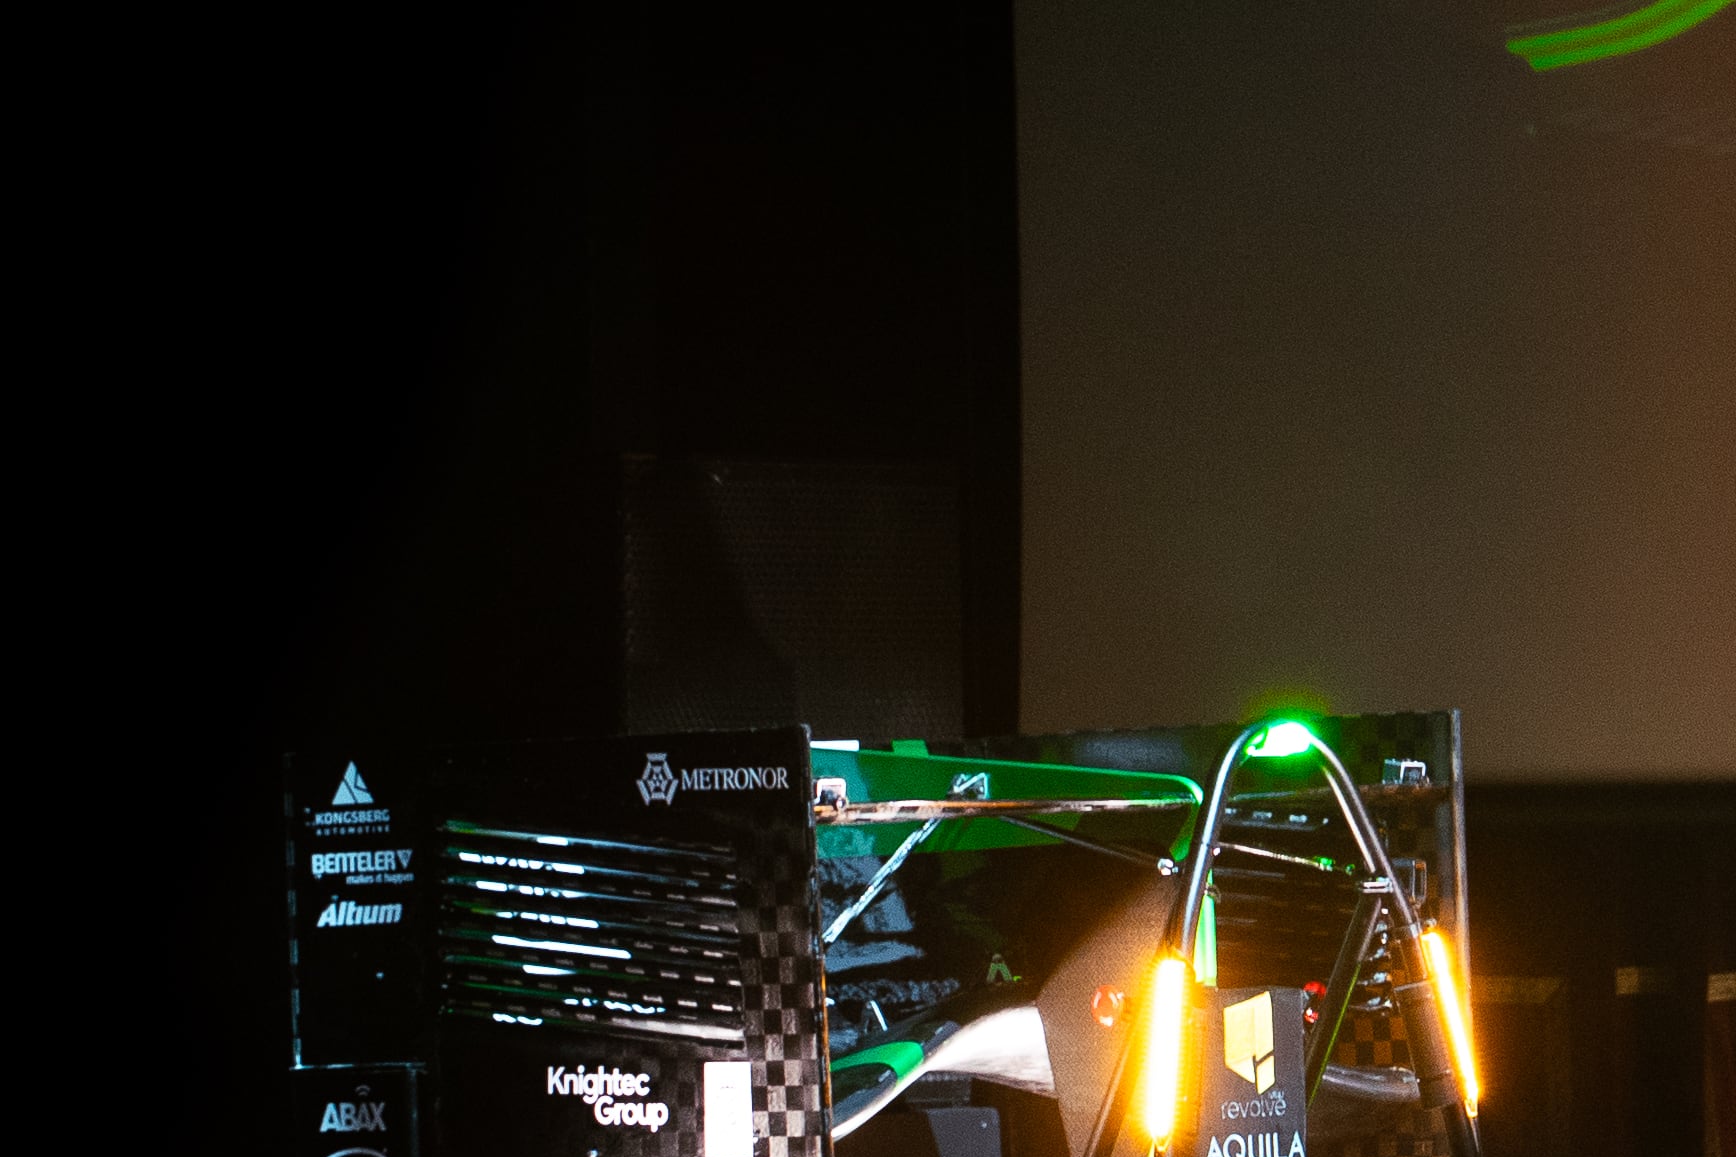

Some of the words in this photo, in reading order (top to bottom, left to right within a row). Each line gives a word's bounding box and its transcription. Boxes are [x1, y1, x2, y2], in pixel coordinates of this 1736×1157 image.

[681, 767, 789, 791] METRONOR
[315, 809, 390, 825] KONGSBERG
[311, 850, 396, 875] BENTELER
[548, 1065, 650, 1104] Knightec
[320, 1102, 386, 1132] ABAX
[594, 1097, 669, 1133] Group
[1221, 1097, 1287, 1119] revolve
